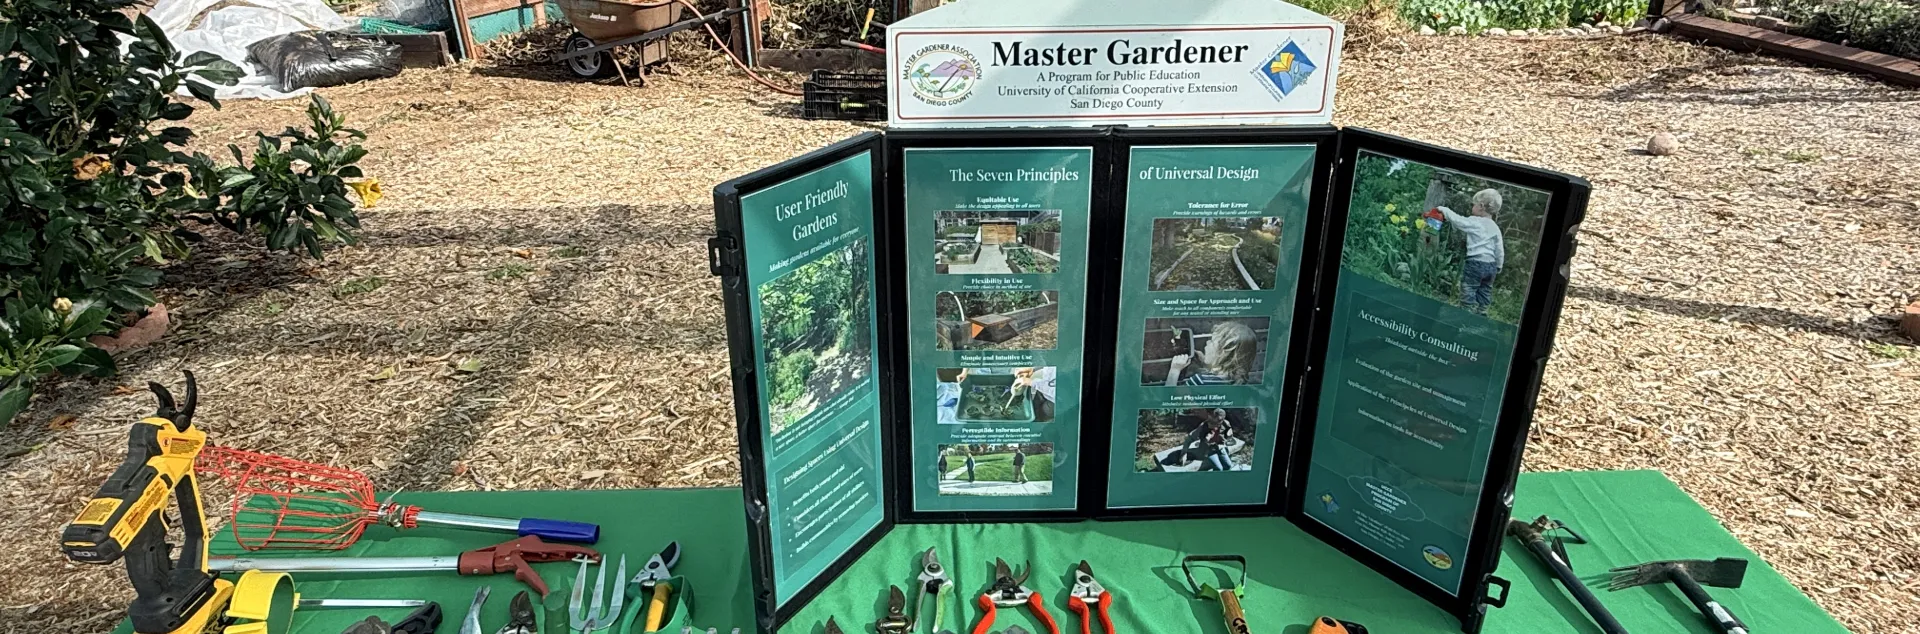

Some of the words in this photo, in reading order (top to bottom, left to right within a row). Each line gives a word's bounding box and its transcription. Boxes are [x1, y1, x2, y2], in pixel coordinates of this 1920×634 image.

[991, 42, 1097, 66] Master
[1107, 39, 1248, 65] Gardener
[903, 55, 916, 80] MASTER
[917, 44, 949, 56] GARDENER
[951, 45, 982, 80] ASSOCIATION
[1037, 72, 1046, 81] A
[1049, 72, 1092, 83] Program
[1096, 71, 1111, 81] for
[1114, 70, 1145, 80] Public
[1149, 70, 1200, 80] Education
[998, 85, 1051, 97] University
[1054, 85, 1066, 95] of
[1068, 84, 1119, 95] California
[1123, 84, 1184, 96] Cooperative
[1188, 83, 1237, 93] Extension
[913, 92, 925, 102] SAN
[926, 98, 947, 106] DIEGO
[949, 91, 973, 105] COUNTY
[1070, 99, 1089, 108] San
[1093, 99, 1123, 110] Diego
[1126, 99, 1163, 110] County
[949, 168, 973, 182] The
[977, 169, 1013, 181] Seven
[1017, 168, 1079, 184] Principles
[1140, 166, 1154, 179] of
[1156, 166, 1213, 179] Universal
[1217, 166, 1259, 181] Design
[775, 201, 802, 221] User
[805, 180, 848, 210] Friendly
[793, 212, 837, 241] Gardens
[1358, 309, 1418, 339] Accessibility
[1419, 332, 1479, 361] Consulting
[1355, 358, 1379, 373] Evaluation
[1385, 370, 1393, 378] the
[1394, 373, 1412, 386] garden
[1422, 385, 1432, 393] and
[1433, 390, 1466, 406] management
[1347, 380, 1372, 393] Application
[1424, 412, 1448, 426] Universal
[1449, 421, 1467, 433] Design
[1358, 408, 1385, 424] Information
[784, 463, 807, 484] Designing
[808, 455, 823, 467] Spaces
[823, 444, 836, 456] Using
[1366, 482, 1382, 493] MASTER
[1383, 492, 1406, 505] GARDENER
[1371, 490, 1392, 503] PROGRAM
[1374, 503, 1392, 513] COUNTY
[1382, 501, 1396, 510] DIEGO
